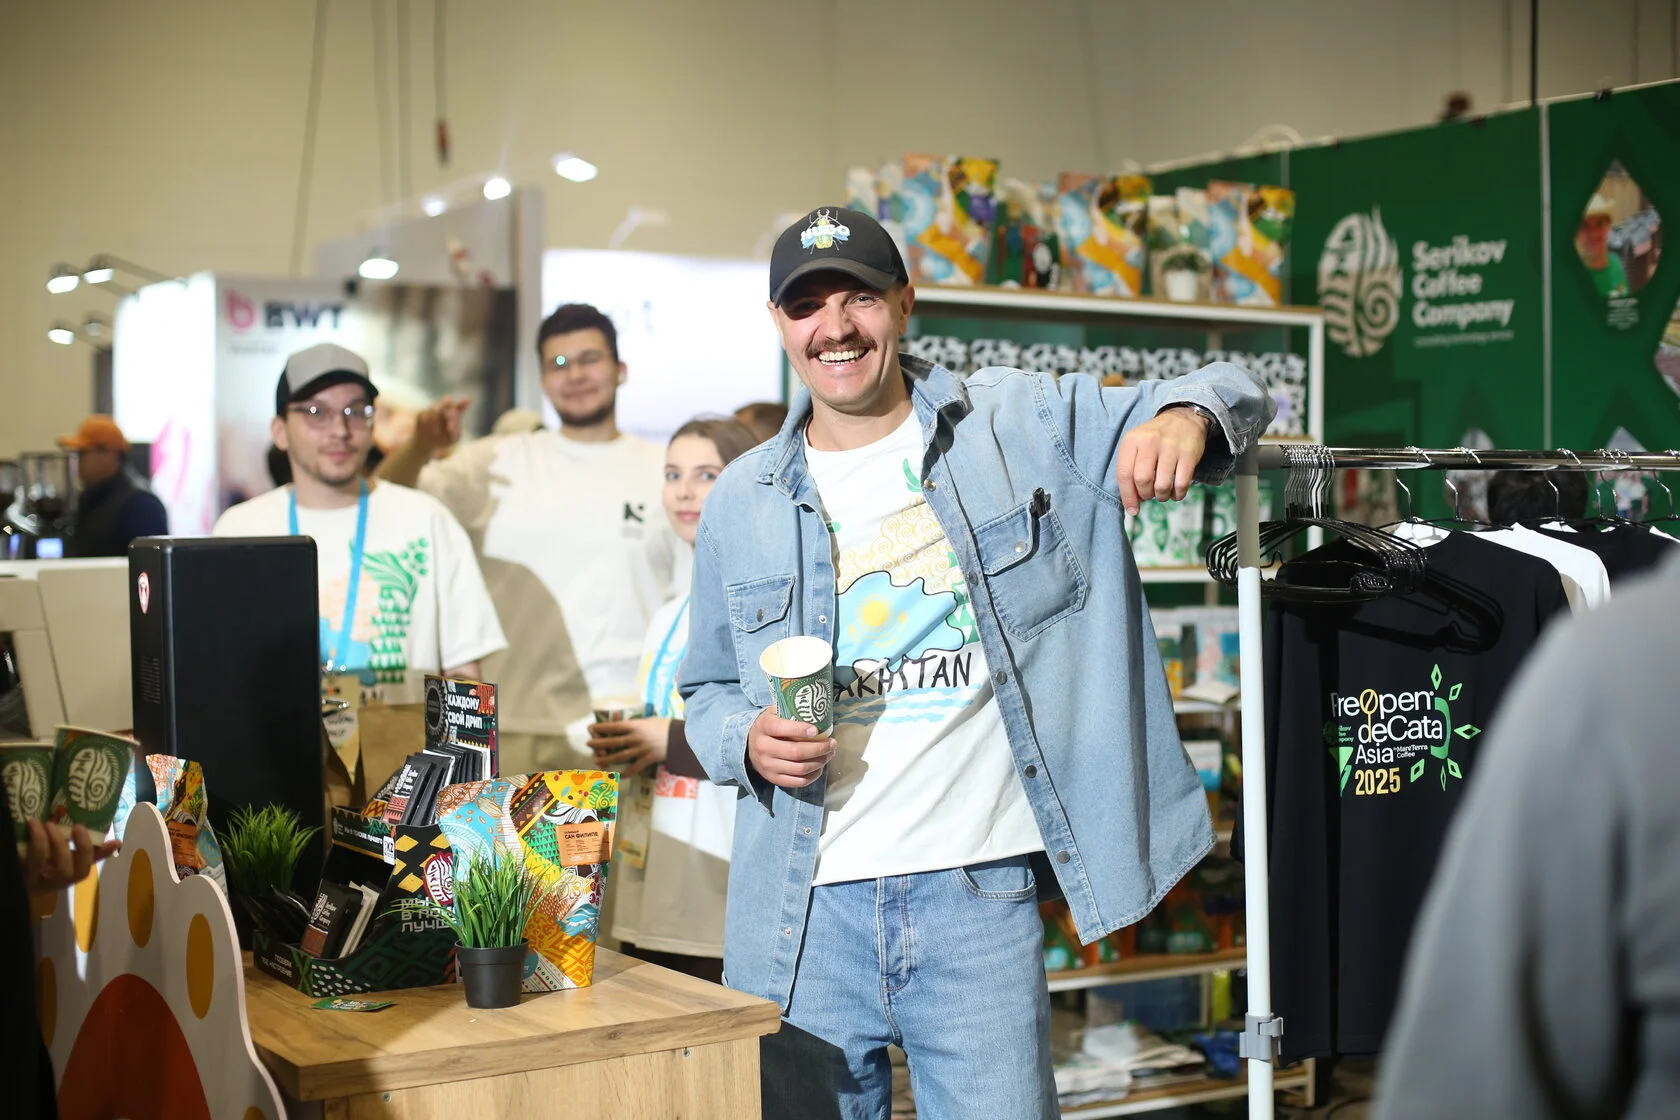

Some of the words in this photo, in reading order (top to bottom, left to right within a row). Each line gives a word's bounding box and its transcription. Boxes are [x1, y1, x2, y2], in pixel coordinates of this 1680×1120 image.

[1411, 267, 1483, 299] Coffee
[264, 300, 343, 329] BWT
[1411, 297, 1515, 332] Company
[447, 694, 480, 711] КАЖДОМУ
[447, 711, 465, 726] СВОЙ
[465, 715, 483, 730] ДРИП
[1357, 715, 1443, 744] deCata
[1355, 742, 1394, 765] Asia
[1355, 767, 1401, 796] 2025
[401, 918, 453, 933] ЛУЧШ
